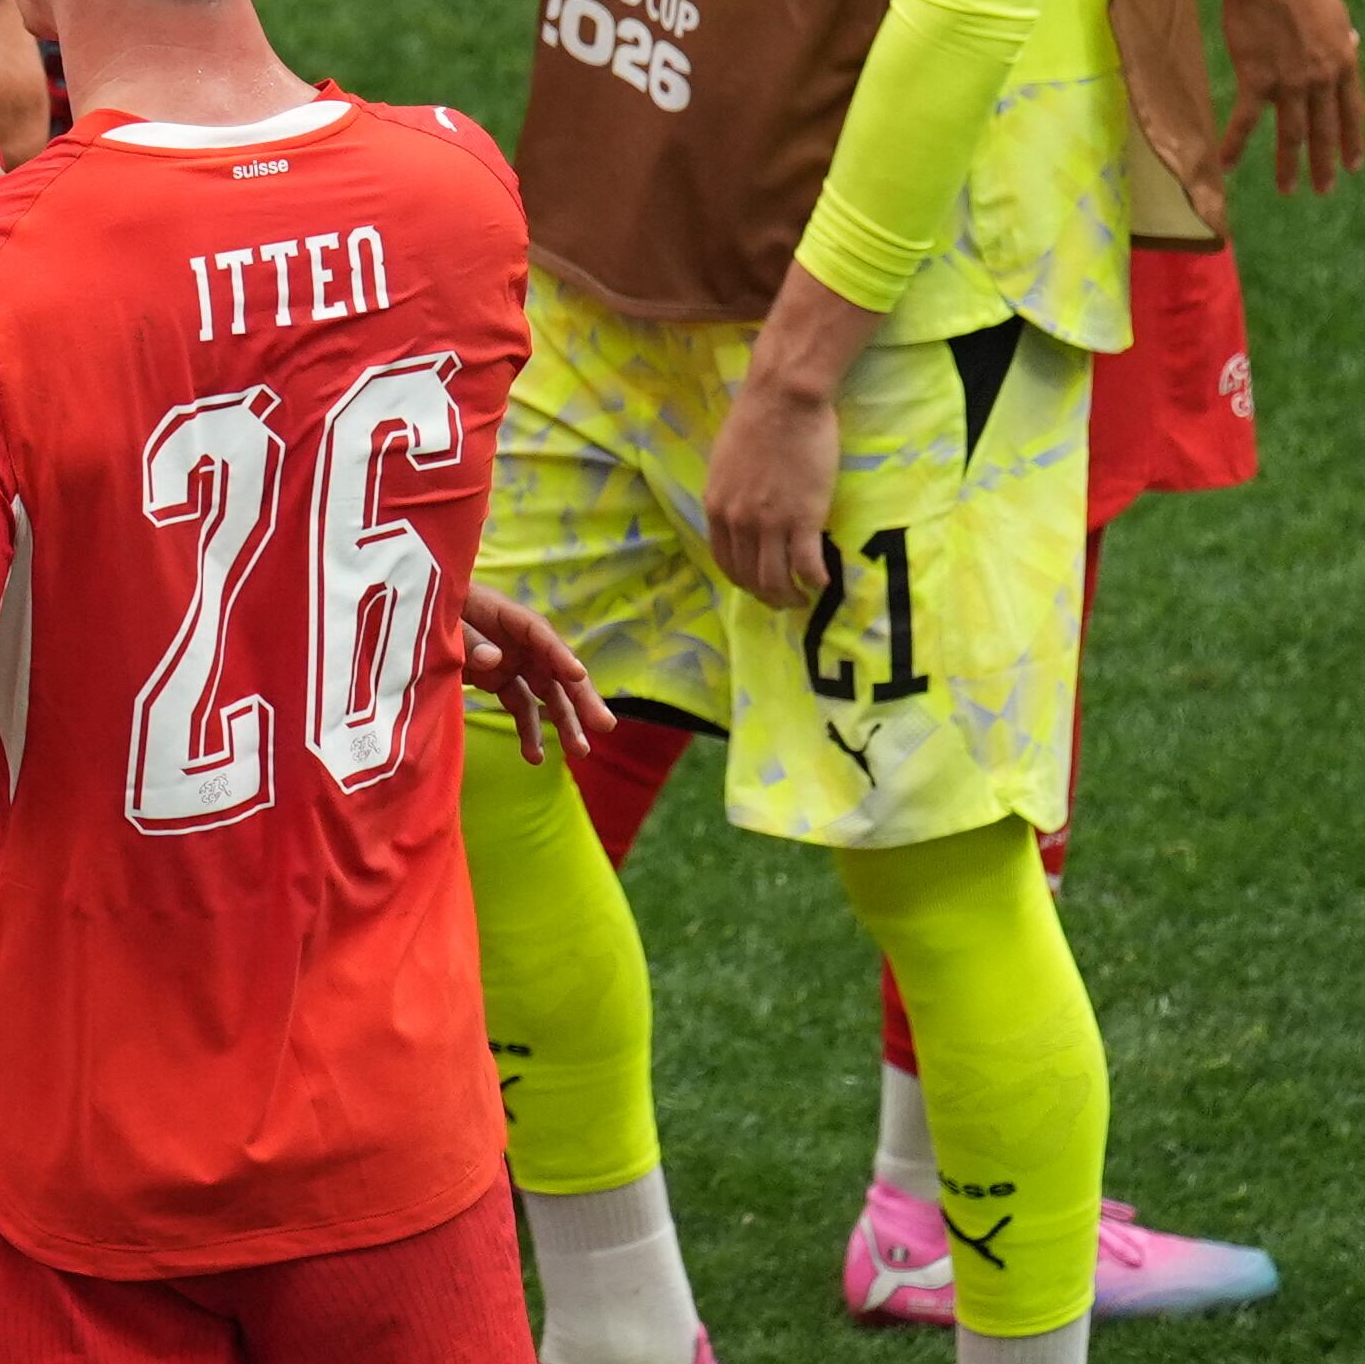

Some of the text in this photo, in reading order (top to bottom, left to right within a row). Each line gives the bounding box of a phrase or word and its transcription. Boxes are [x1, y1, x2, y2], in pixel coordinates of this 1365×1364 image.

[233, 159, 289, 179] suisse
[189, 224, 390, 342] ITTEN
[124, 351, 463, 836] 26
[804, 526, 929, 703] 21
